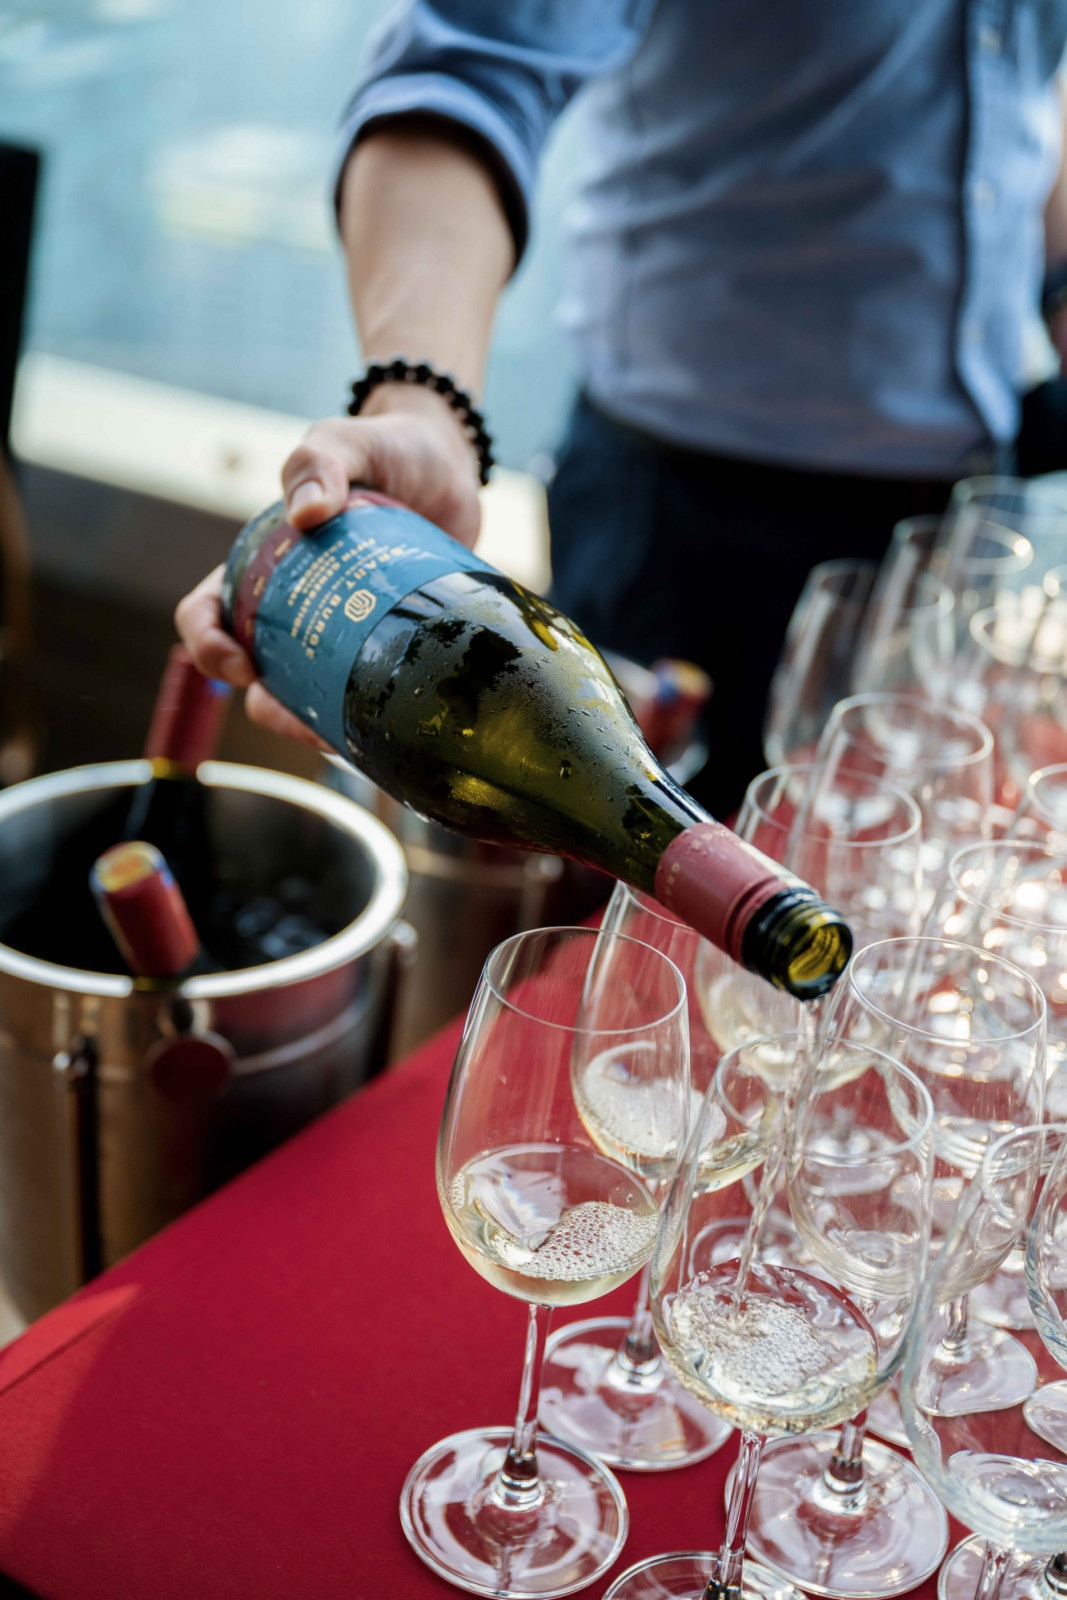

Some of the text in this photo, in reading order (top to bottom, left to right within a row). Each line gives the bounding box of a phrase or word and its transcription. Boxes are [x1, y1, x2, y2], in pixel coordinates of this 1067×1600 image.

[291, 561, 341, 638] GENERATION
[345, 546, 404, 590] GRANT
[305, 593, 342, 659] BURGE
